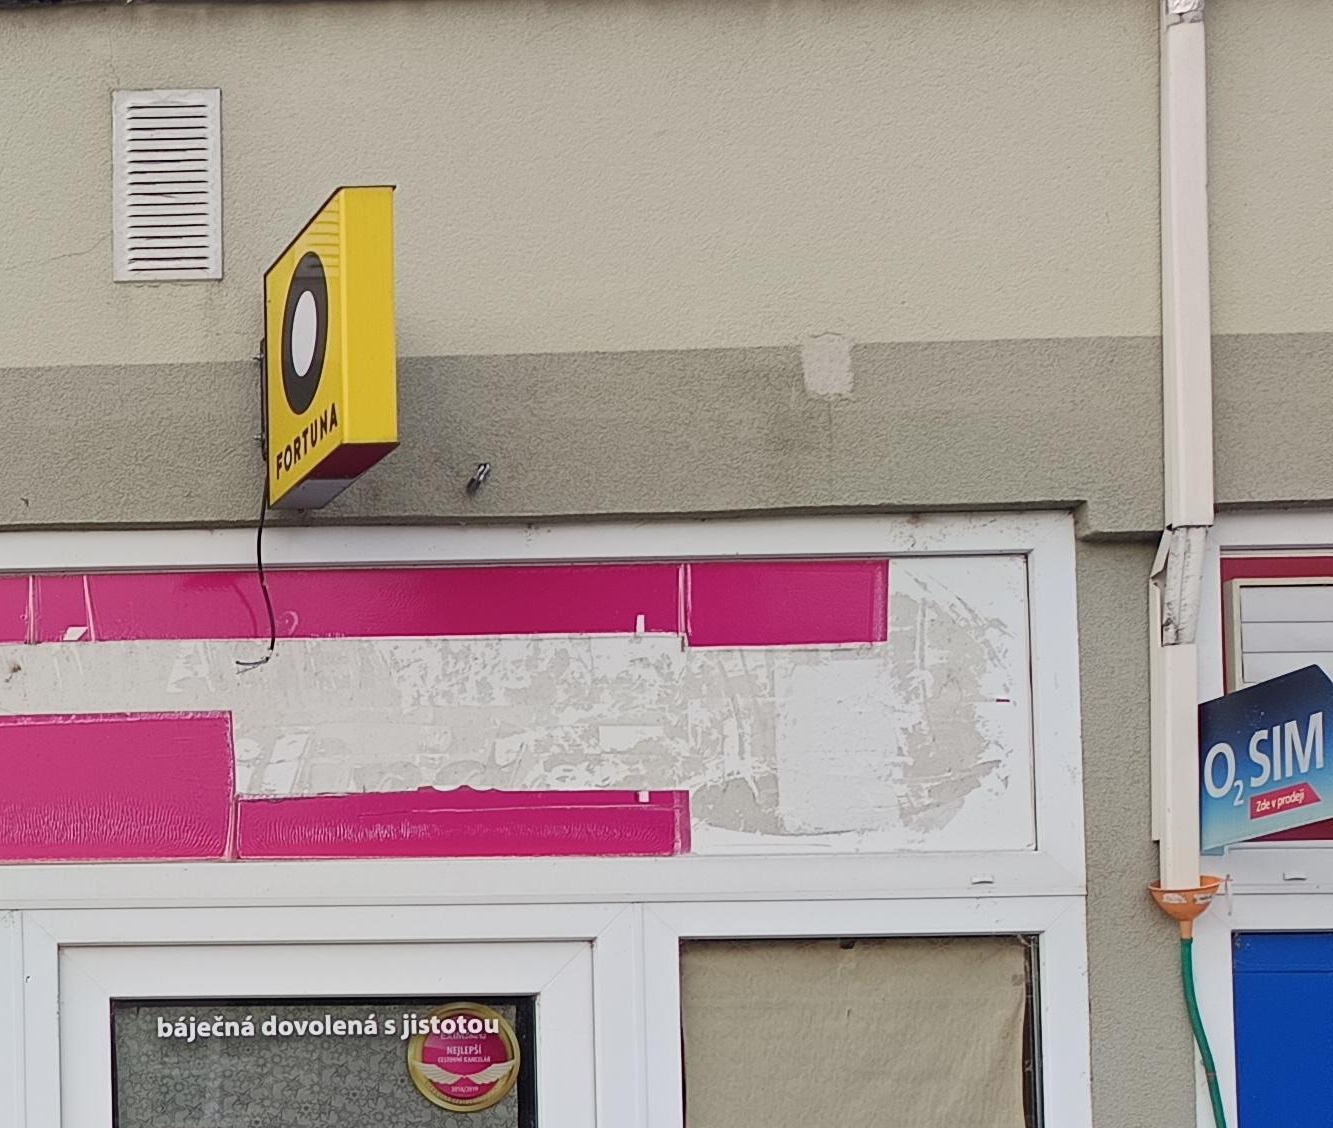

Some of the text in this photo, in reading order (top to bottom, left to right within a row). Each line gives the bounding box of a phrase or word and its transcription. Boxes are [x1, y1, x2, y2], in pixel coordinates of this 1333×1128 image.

[276, 402, 338, 480] FORTUNA
[1248, 711, 1324, 788] SIM
[1256, 788, 1305, 813] Zde v prodeji
[156, 1013, 499, 1042] báječná dovolená s jistotou
[446, 1043, 482, 1056] NEJLEPŠÍ
